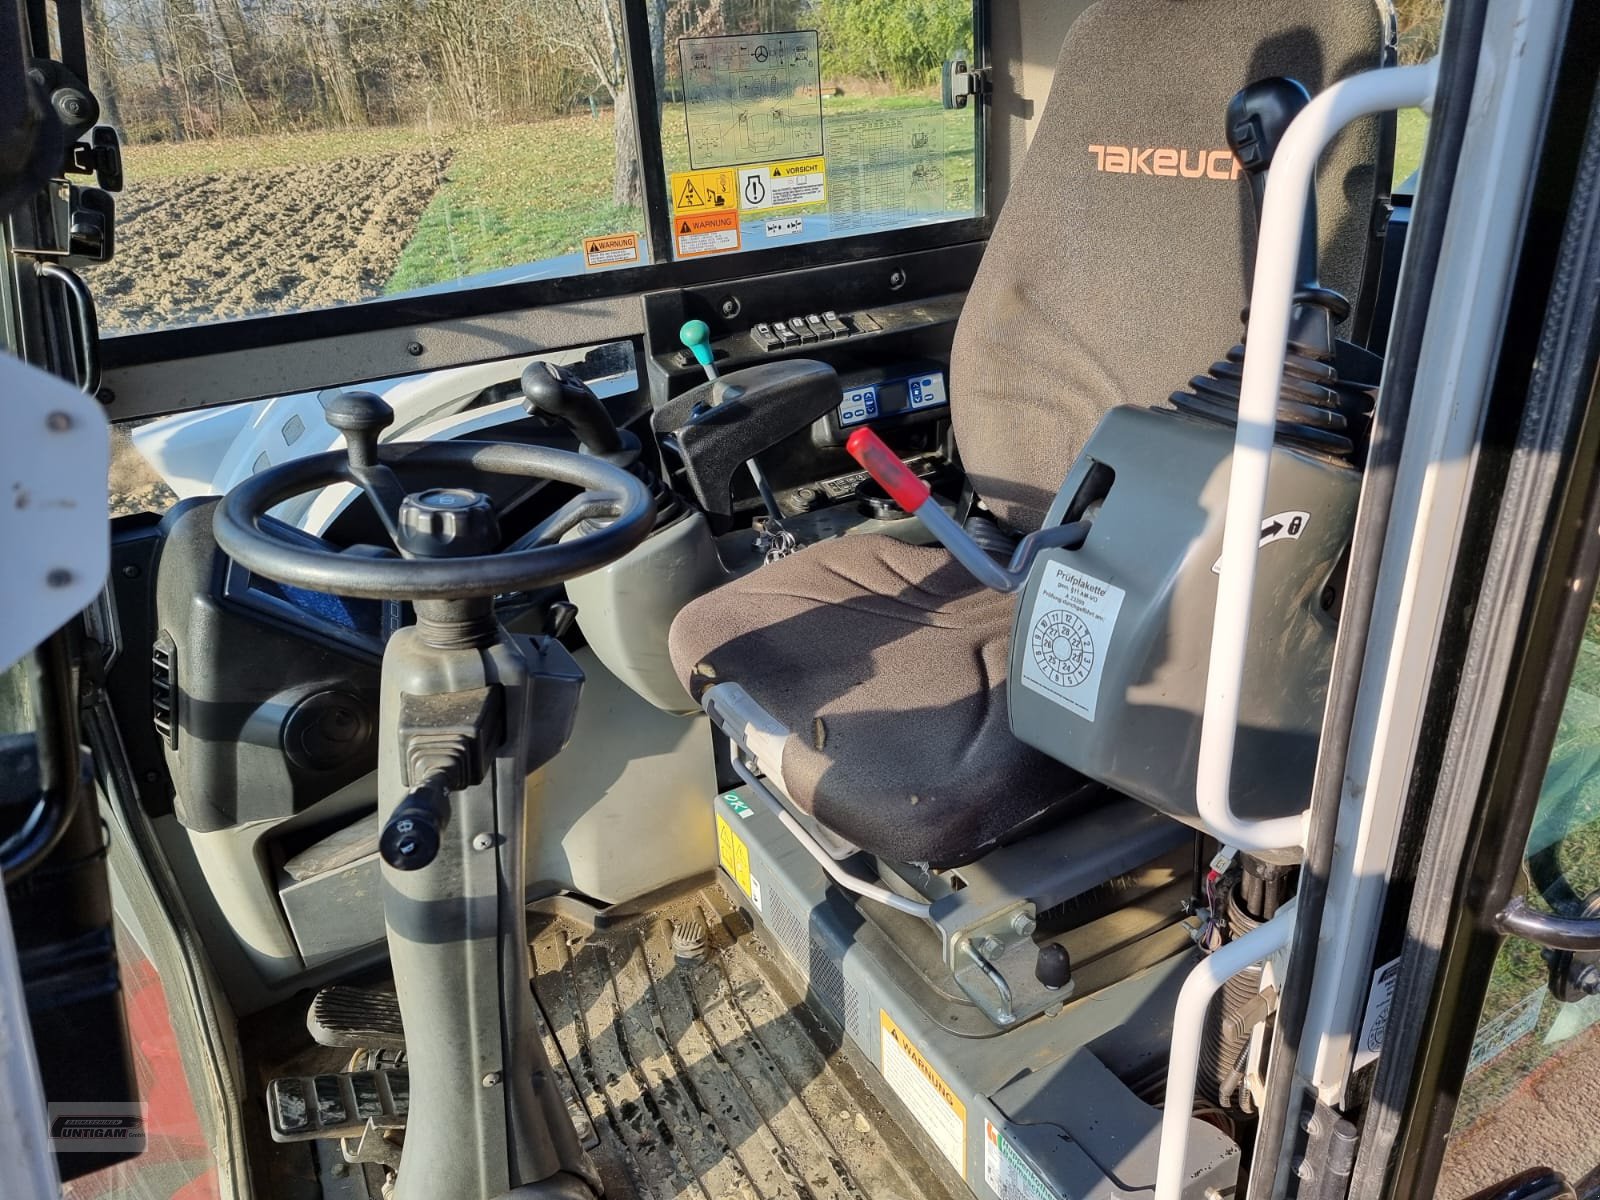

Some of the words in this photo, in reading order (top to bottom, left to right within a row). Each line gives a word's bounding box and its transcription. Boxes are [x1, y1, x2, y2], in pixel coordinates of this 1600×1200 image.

[786, 164, 818, 174] VORSICHT
[692, 218, 732, 229] WARNUNG
[598, 238, 632, 249] WARNUNG
[1065, 614, 1072, 623] 12
[902, 1039, 954, 1106] WARNUNG
